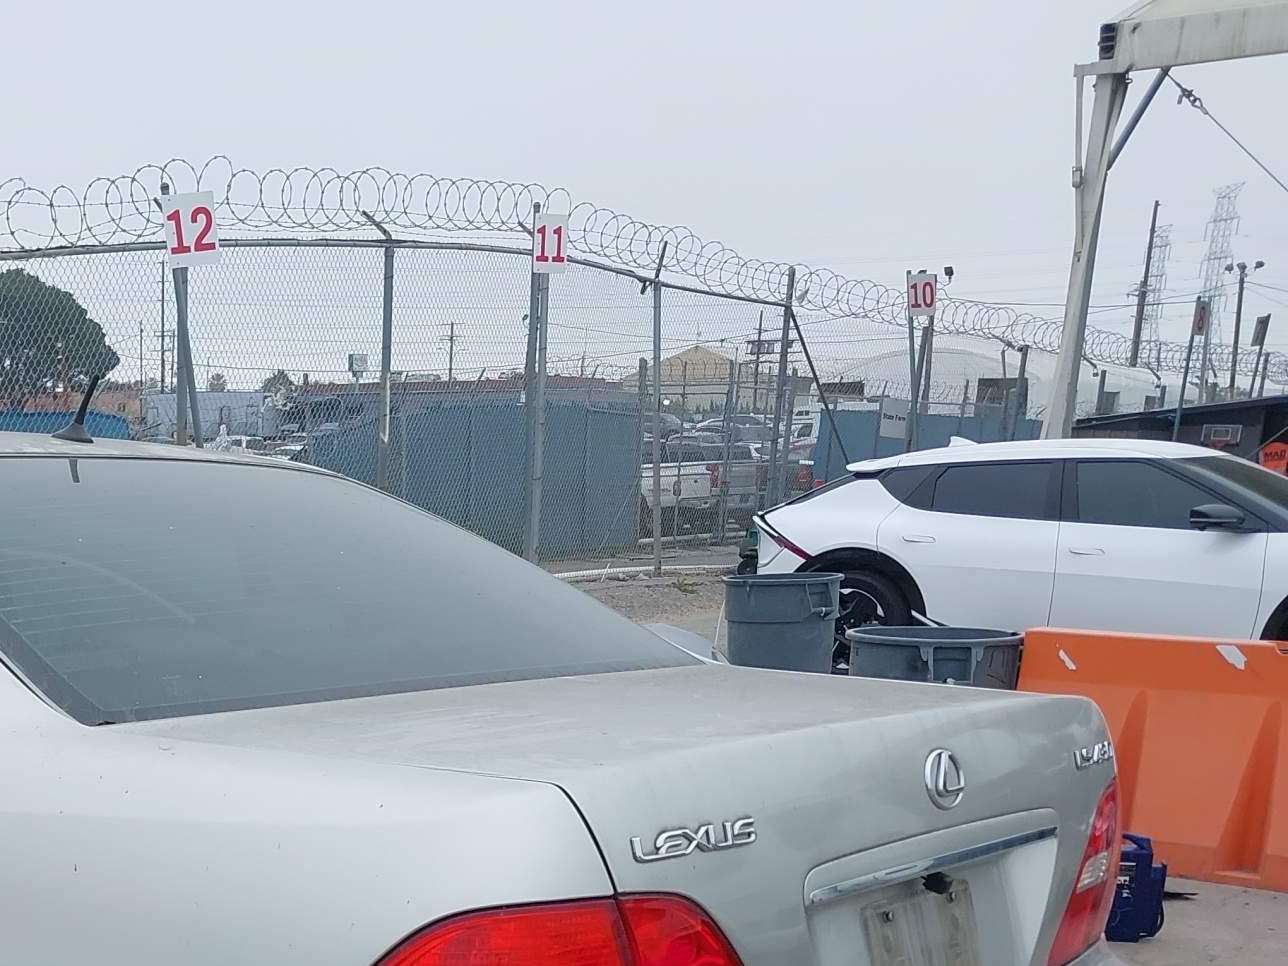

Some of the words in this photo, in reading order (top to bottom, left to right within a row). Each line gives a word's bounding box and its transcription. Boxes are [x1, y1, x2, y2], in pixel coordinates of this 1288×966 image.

[166, 206, 217, 255] 12
[536, 225, 565, 263] 11
[909, 281, 935, 309] 10
[629, 815, 758, 863] LEXUS
